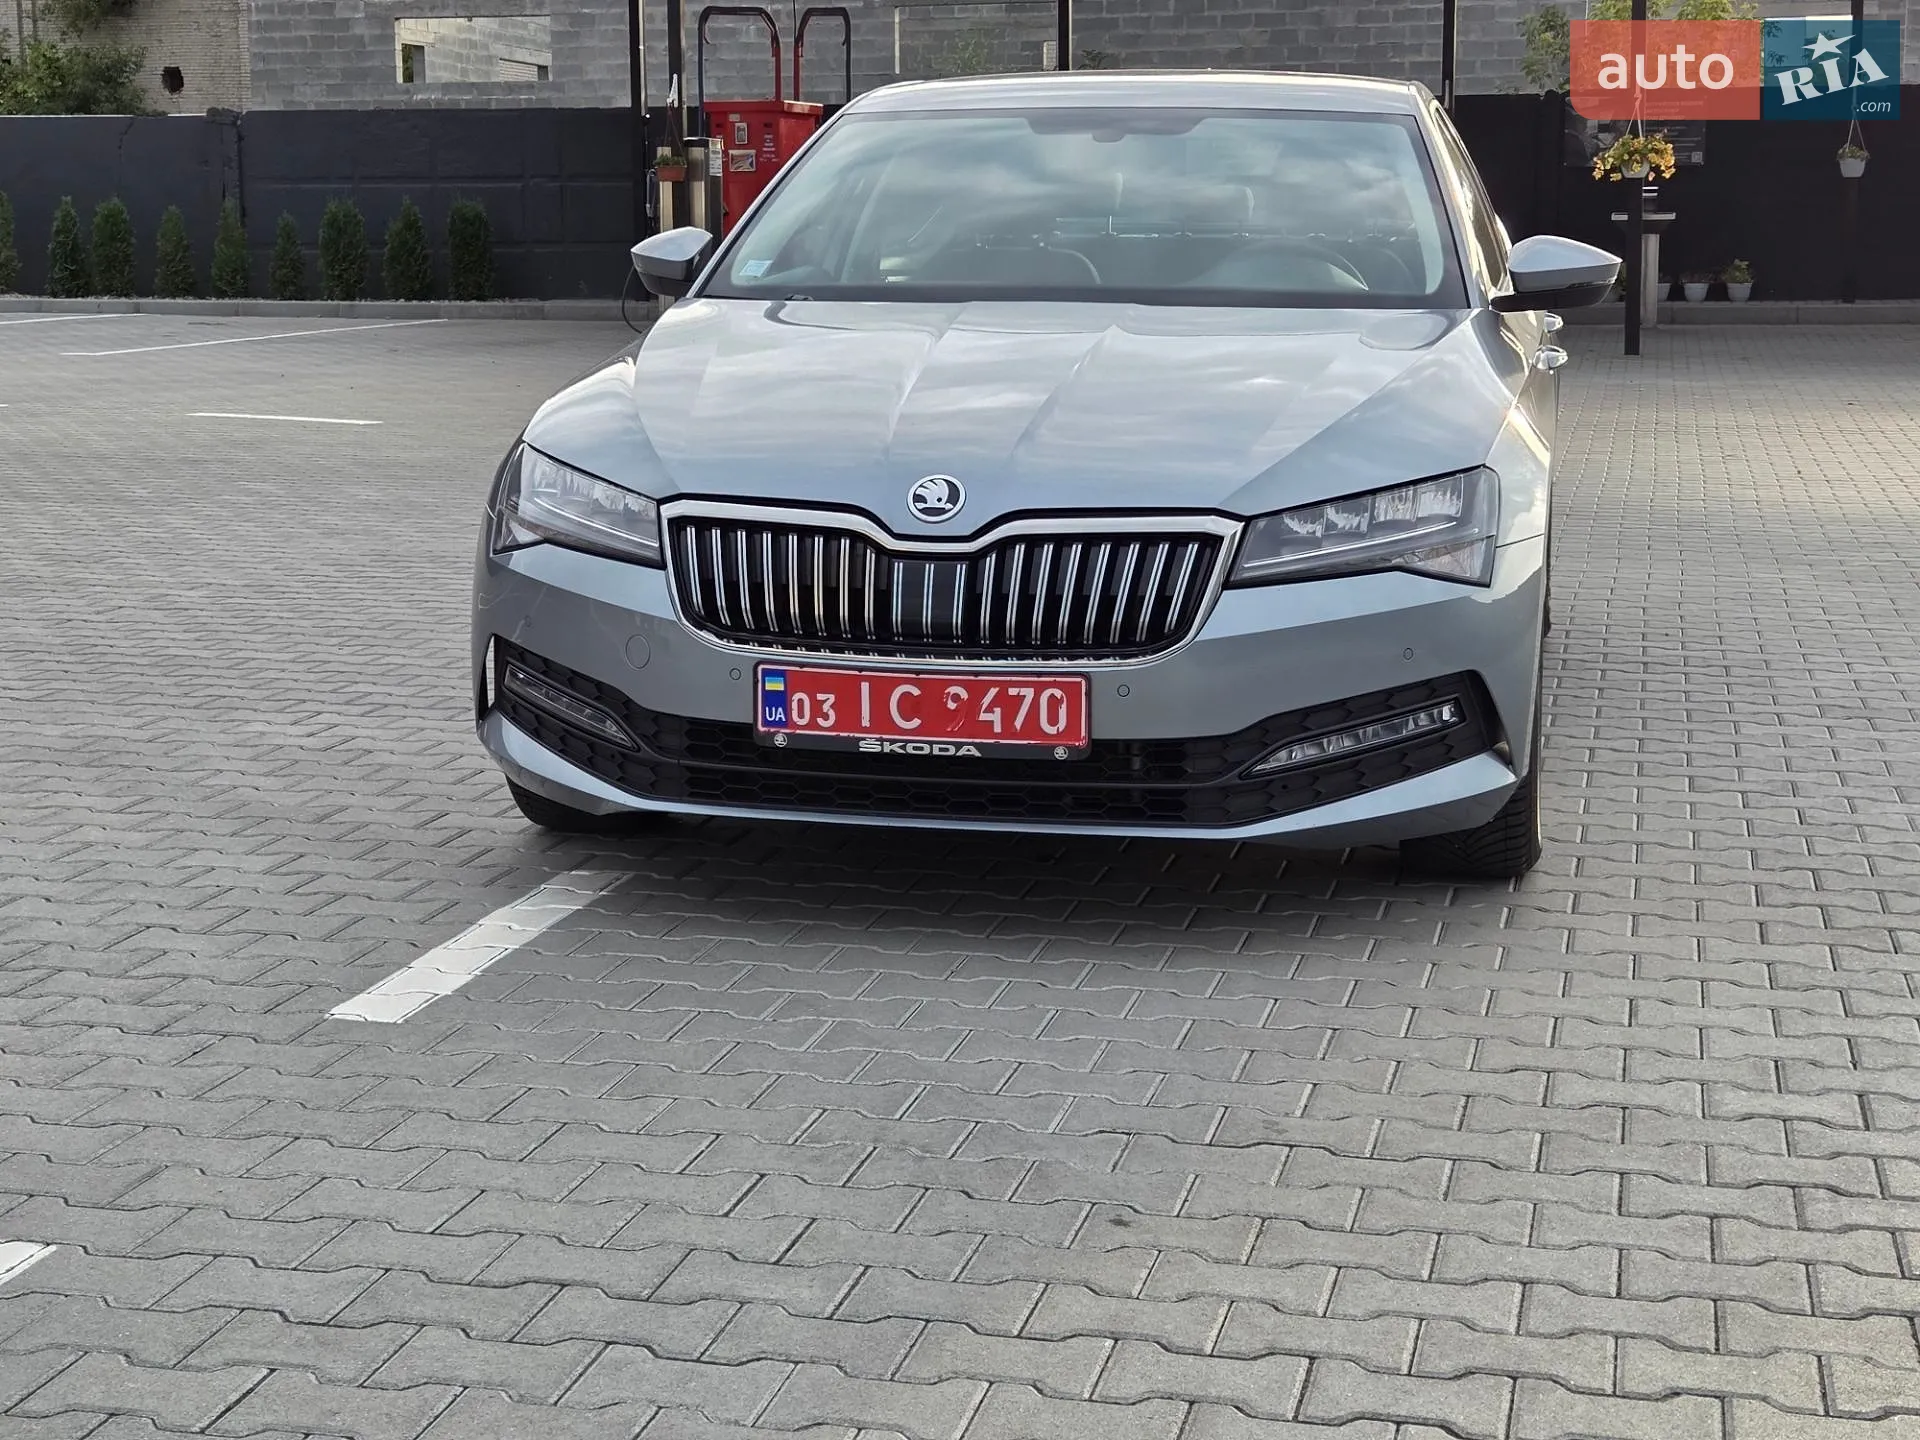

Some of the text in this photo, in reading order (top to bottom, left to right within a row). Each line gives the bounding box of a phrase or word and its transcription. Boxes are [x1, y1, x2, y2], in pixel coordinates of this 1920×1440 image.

[765, 706, 787, 723] UA
[791, 691, 836, 728] 03
[858, 738, 982, 757] ŠKODA
